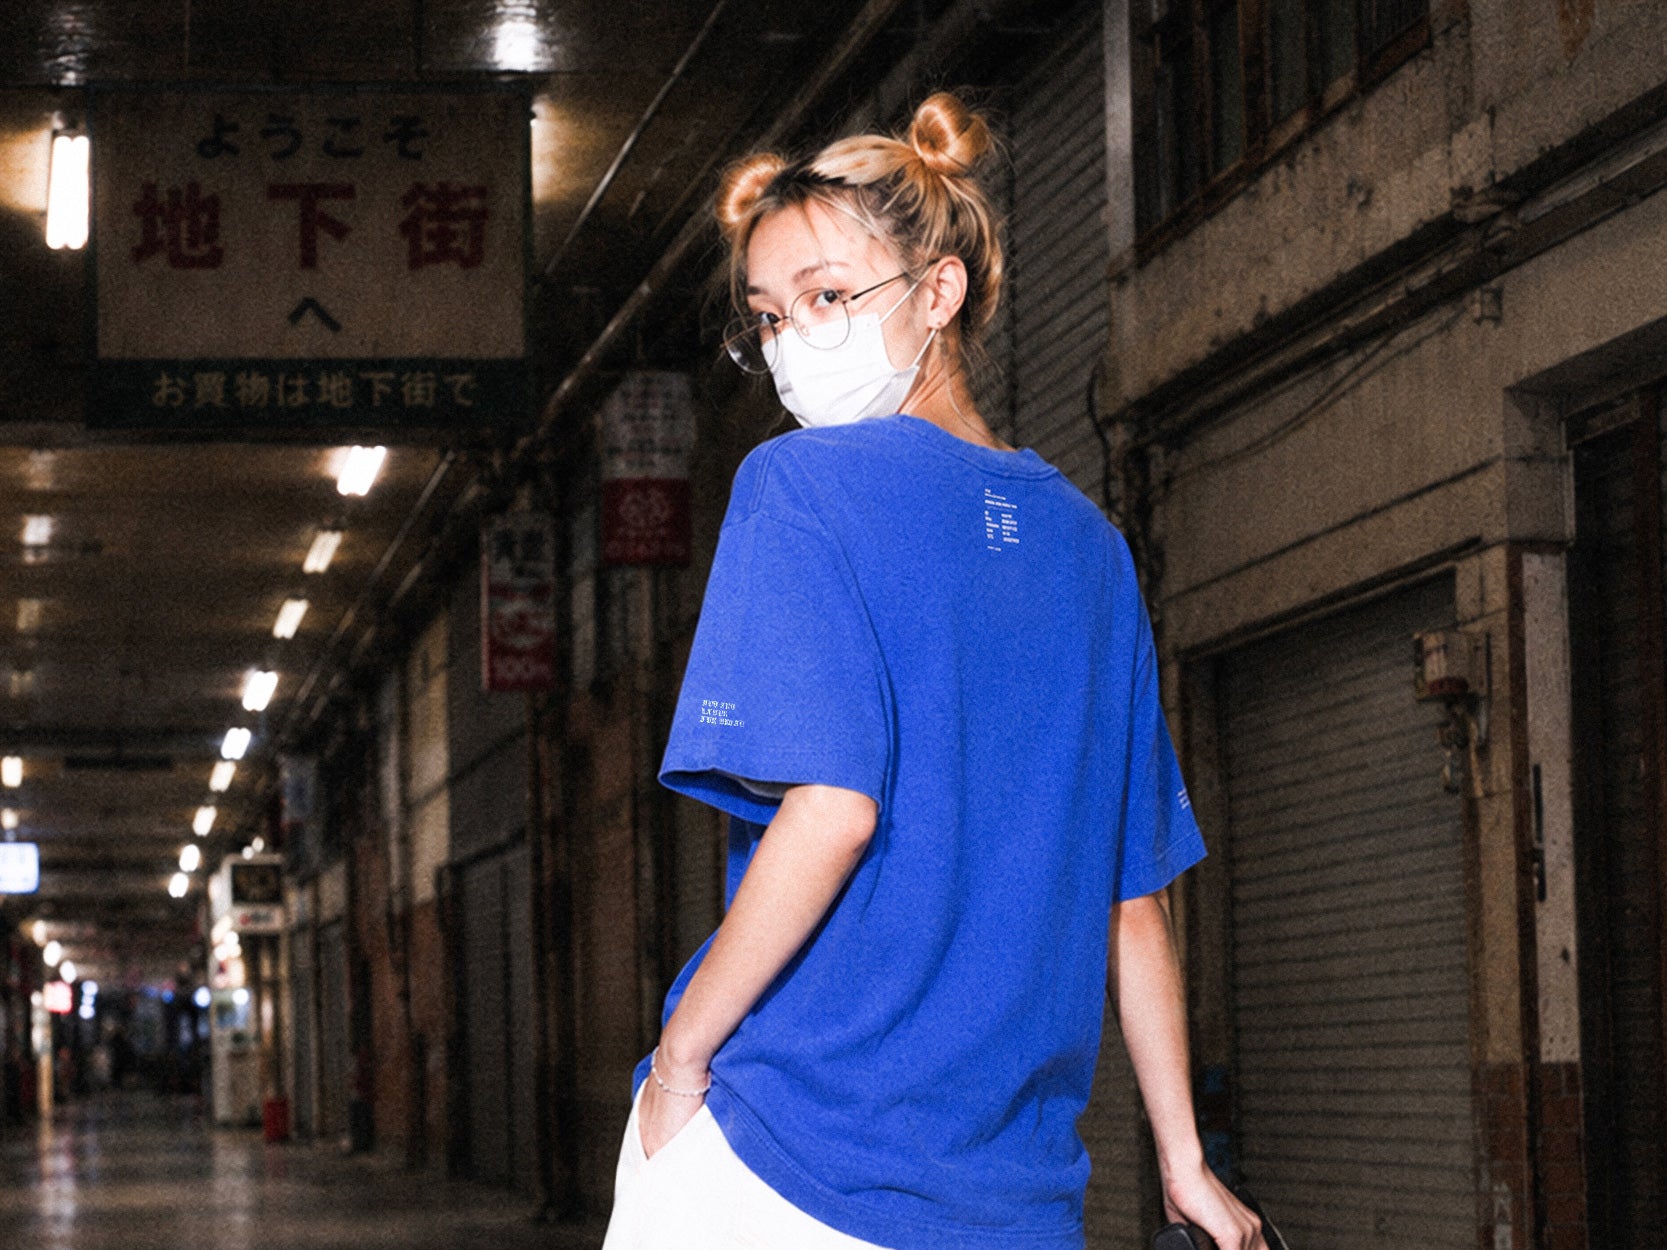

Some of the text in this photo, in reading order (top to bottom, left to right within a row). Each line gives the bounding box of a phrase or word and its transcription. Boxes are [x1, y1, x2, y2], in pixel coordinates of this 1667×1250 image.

[197, 113, 430, 160] ようこそ
[131, 182, 489, 270] 地下街
[288, 297, 341, 333] へ
[151, 369, 478, 409] お買物は地下街で
